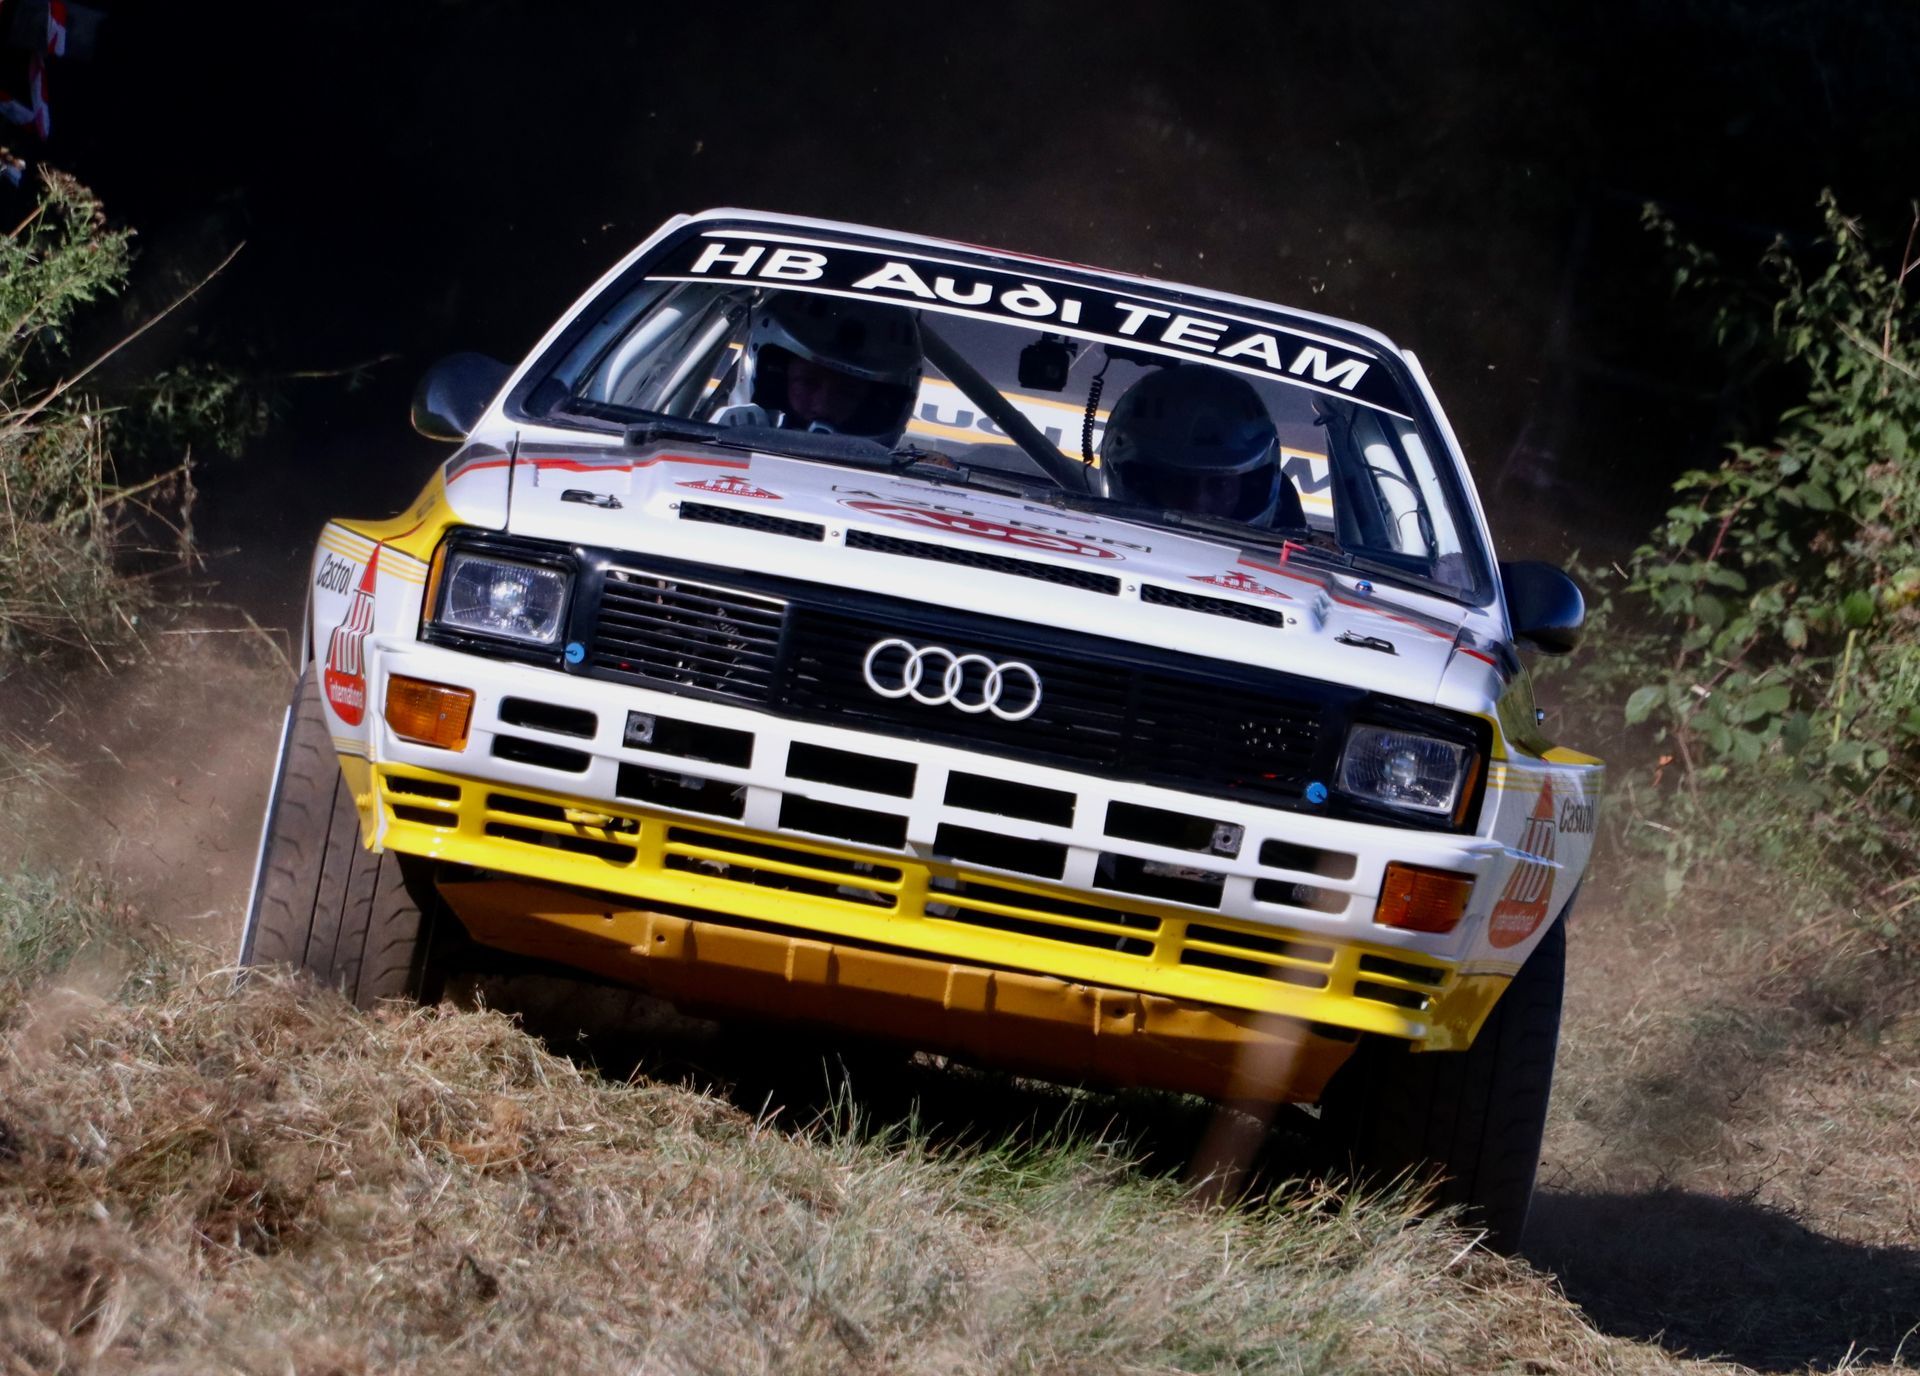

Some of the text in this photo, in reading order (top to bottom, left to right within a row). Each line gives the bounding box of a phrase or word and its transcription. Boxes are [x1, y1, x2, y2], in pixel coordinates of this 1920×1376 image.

[690, 243, 828, 281] HB
[1113, 302, 1371, 391] TEAM
[316, 552, 357, 596] Castrol
[1559, 797, 1594, 834] Castrol
